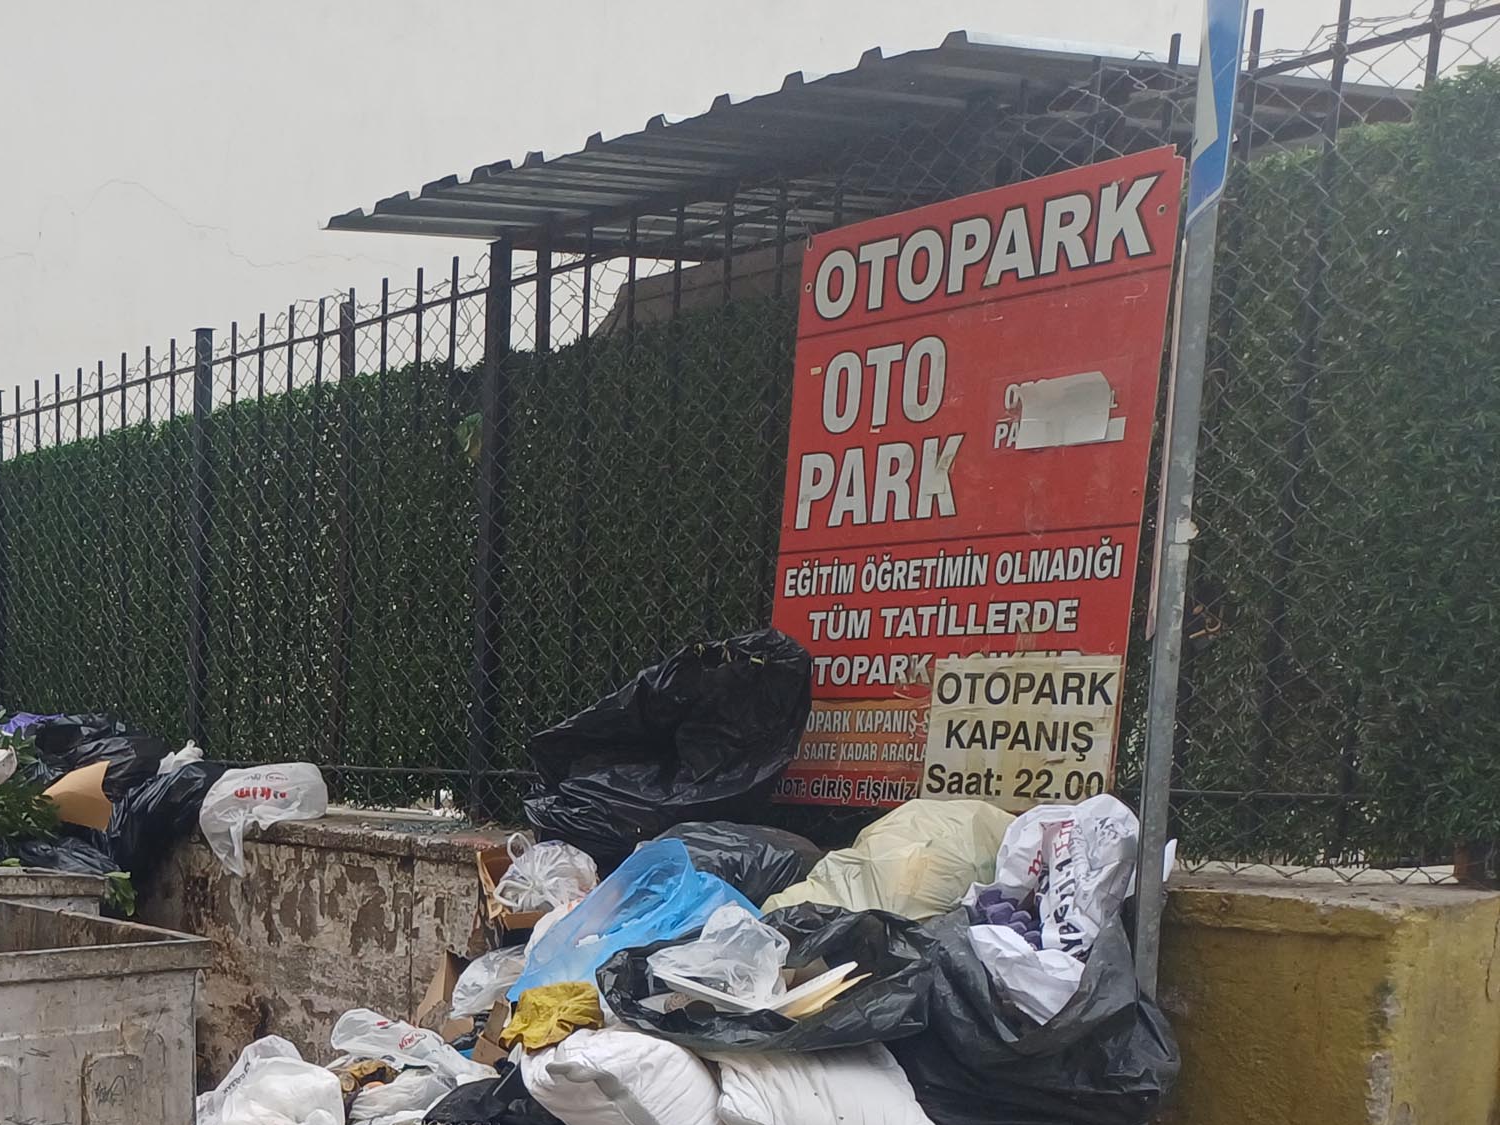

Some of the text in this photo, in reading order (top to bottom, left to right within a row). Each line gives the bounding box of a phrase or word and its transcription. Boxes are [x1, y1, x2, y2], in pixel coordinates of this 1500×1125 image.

[814, 174, 1161, 320] OTOPARK
[822, 336, 947, 434] OTO
[795, 434, 965, 530] PARK
[783, 537, 1124, 597] EĞİTİM ÖĞRETİMİN OLMADIĞI
[808, 598, 1081, 641] TÜM TATİLLERDE
[811, 654, 933, 686] TOPARK
[936, 672, 1117, 705] OTOPARK
[805, 710, 851, 733] OPARK
[855, 709, 918, 739] KAPANIŞ
[945, 719, 1094, 762] KAPANIŞ
[803, 742, 837, 761] SAATE
[840, 742, 878, 761] KADAR
[810, 775, 851, 804] GİRİŞ
[925, 763, 1104, 801] Saat: 22.00
